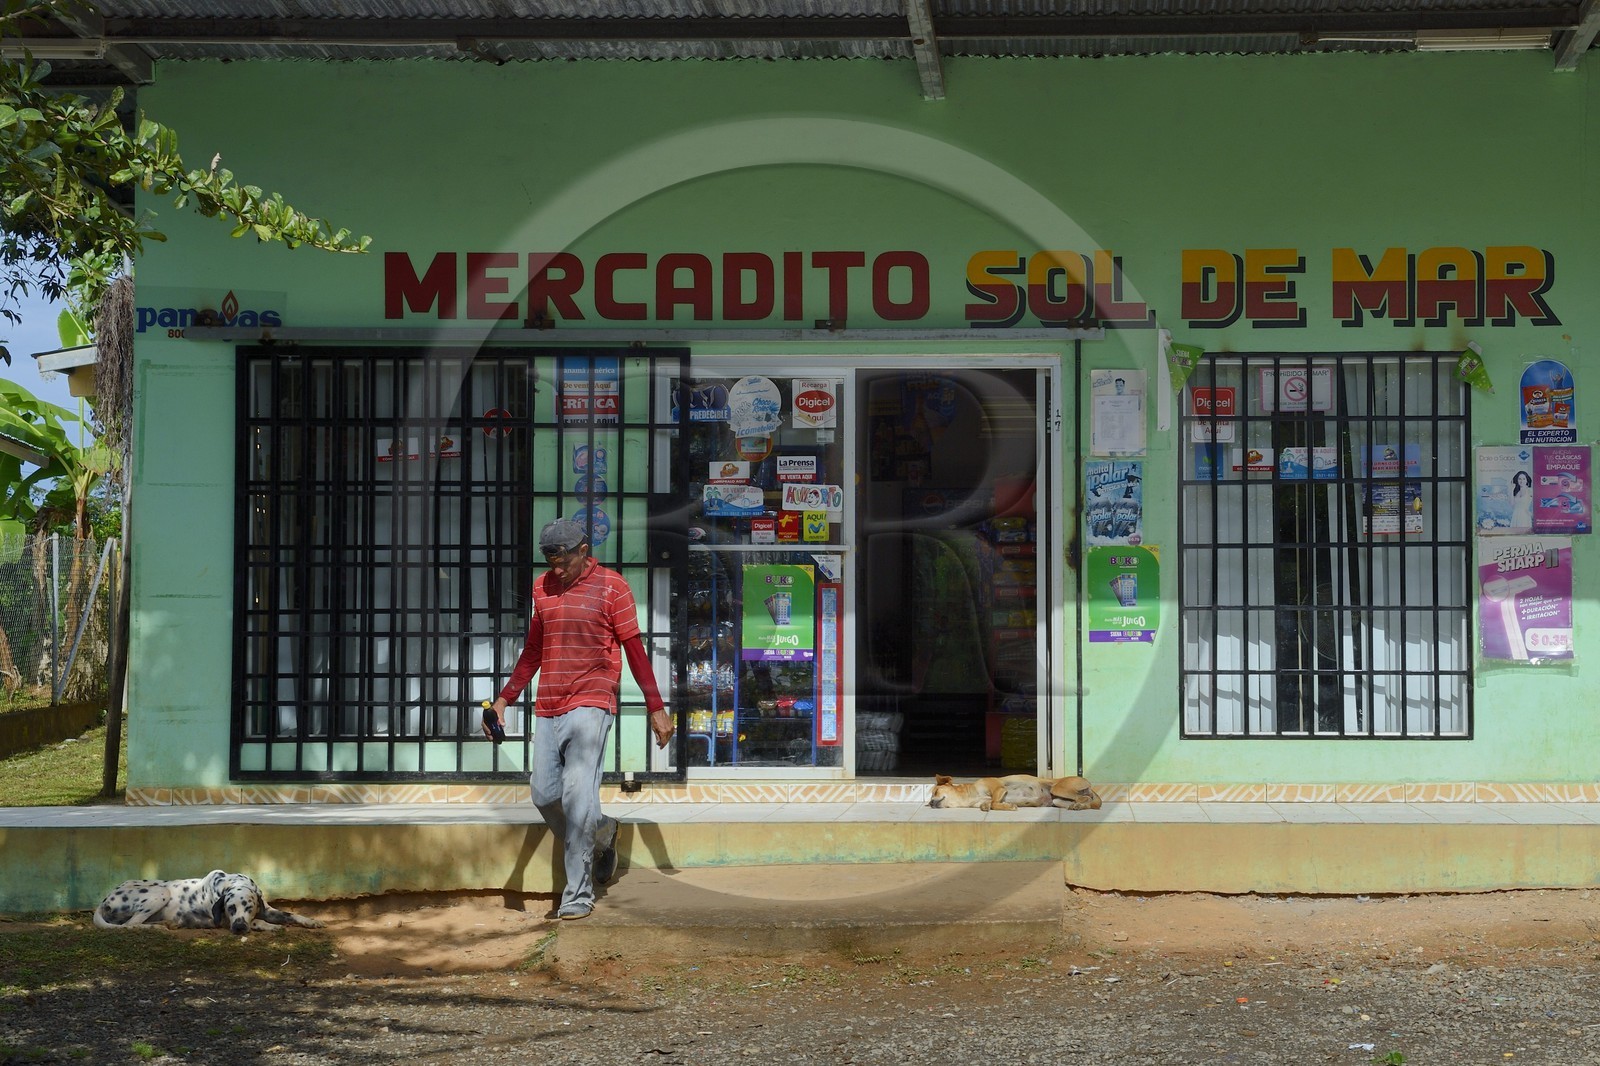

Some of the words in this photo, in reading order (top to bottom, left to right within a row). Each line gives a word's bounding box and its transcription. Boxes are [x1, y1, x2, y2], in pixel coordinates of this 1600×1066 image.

[385, 251, 930, 321] MERCADITO
[965, 249, 1155, 328] SOL
[1181, 248, 1307, 329] DE
[1332, 246, 1562, 327] MAR
[798, 397, 830, 408] Digicel
[1196, 397, 1231, 410] Digcel
[1087, 465, 1109, 476] malta
[1090, 462, 1129, 491] polar
[1494, 542, 1544, 560] PERMA
[1497, 554, 1545, 573] SHARP
[1122, 616, 1146, 627] JUEGO
[775, 634, 799, 646] JUEGO
